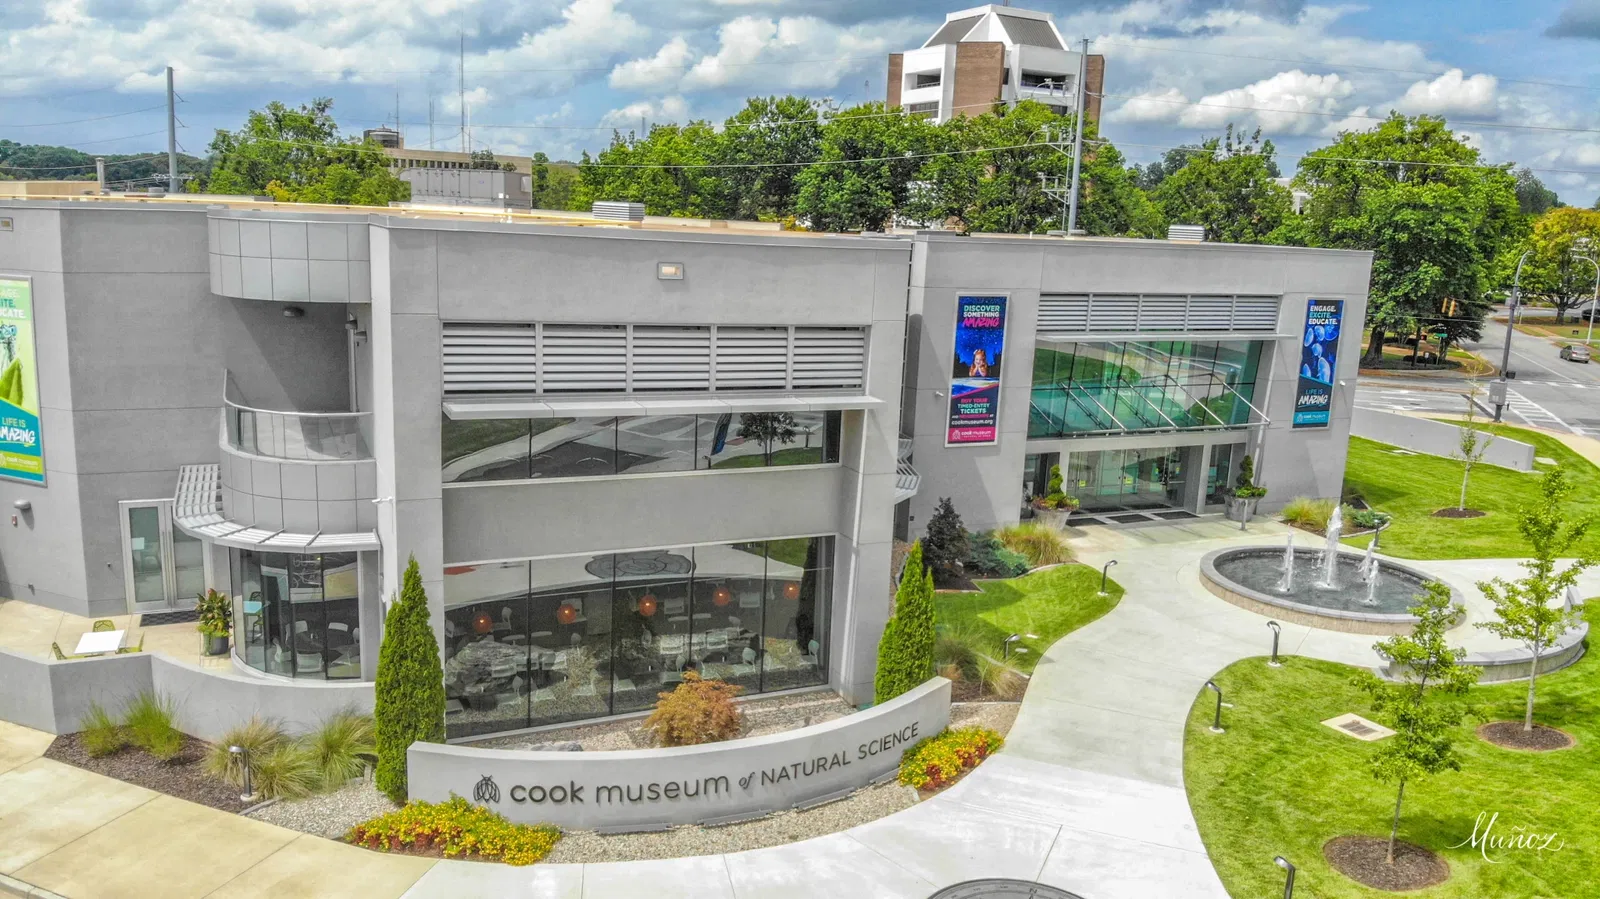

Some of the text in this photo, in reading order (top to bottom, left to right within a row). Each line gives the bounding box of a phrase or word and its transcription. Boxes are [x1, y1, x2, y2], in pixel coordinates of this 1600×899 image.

[963, 317, 1000, 327] AMAZING
[1298, 395, 1328, 405] AMAZING
[2, 416, 27, 428] LIFE IS
[0, 425, 36, 444] MAZING
[509, 721, 920, 803] cook museum of NATURAL SCIENCE
